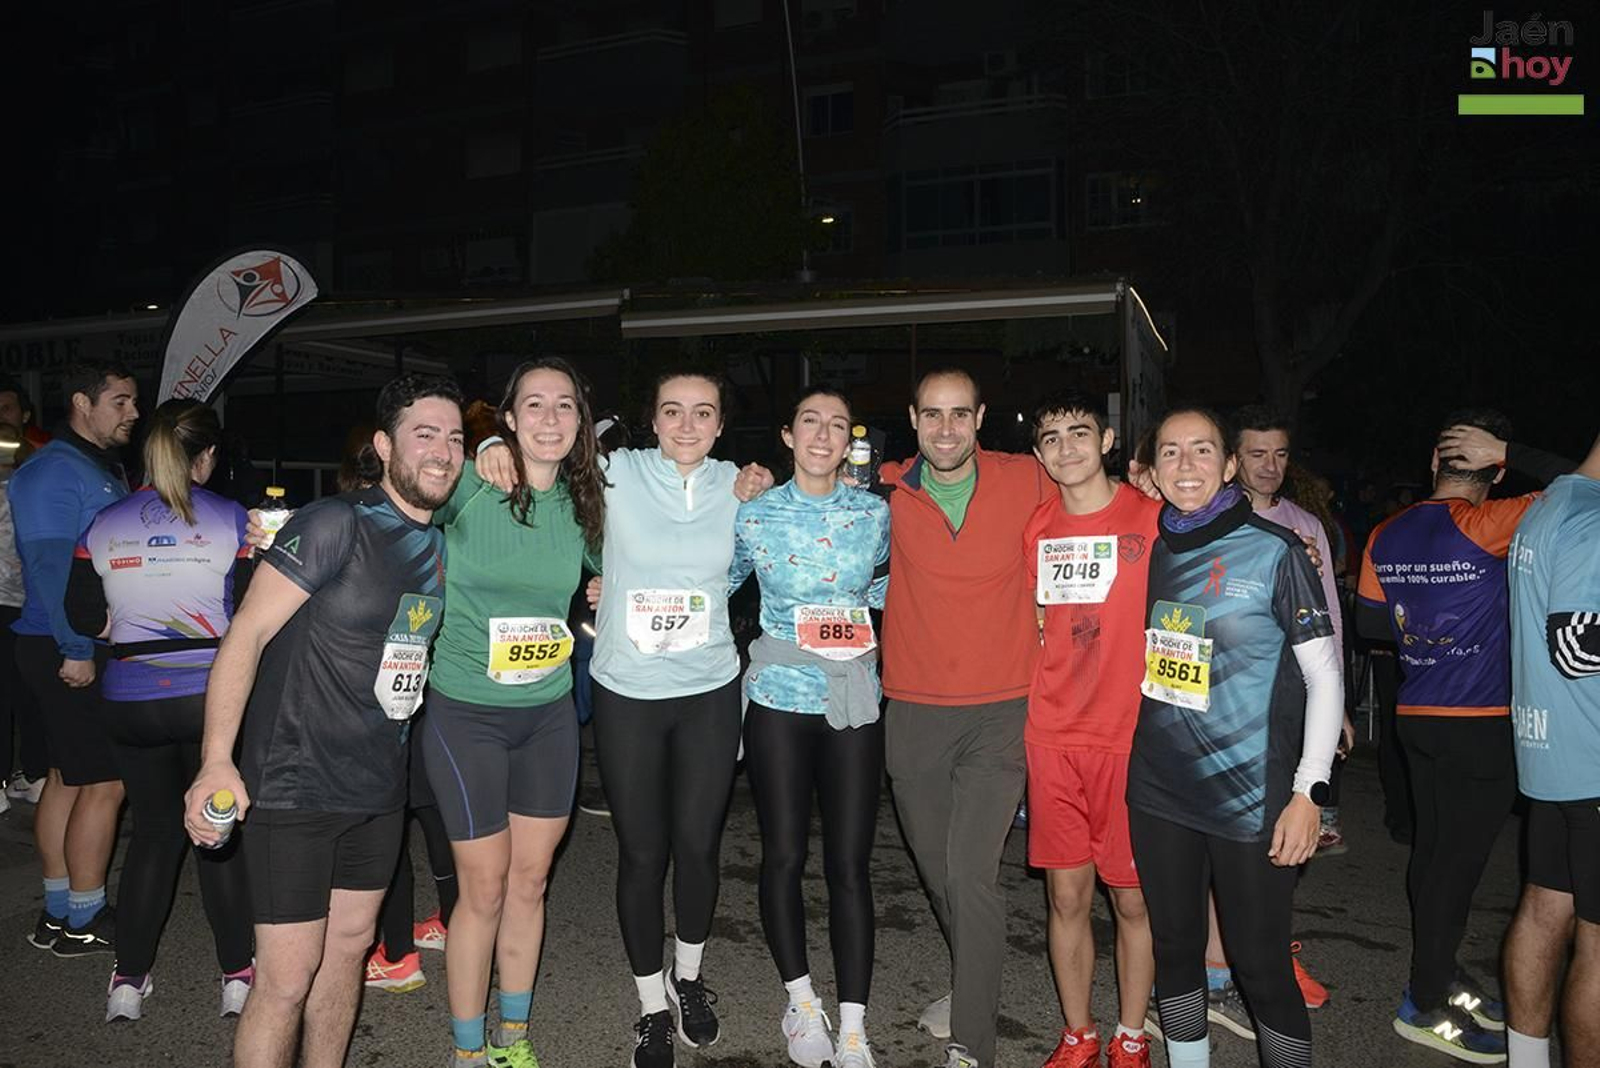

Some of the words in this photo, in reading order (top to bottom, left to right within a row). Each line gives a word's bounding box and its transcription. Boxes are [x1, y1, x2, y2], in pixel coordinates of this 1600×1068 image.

[1052, 562, 1100, 580] 7048
[1395, 563, 1413, 575] por
[1414, 563, 1428, 572] un
[650, 615, 690, 631] 657
[820, 624, 854, 640] 685
[508, 642, 561, 662] 9552
[382, 660, 398, 670] SAN
[1157, 658, 1202, 684] 9561
[391, 673, 422, 692] 613
